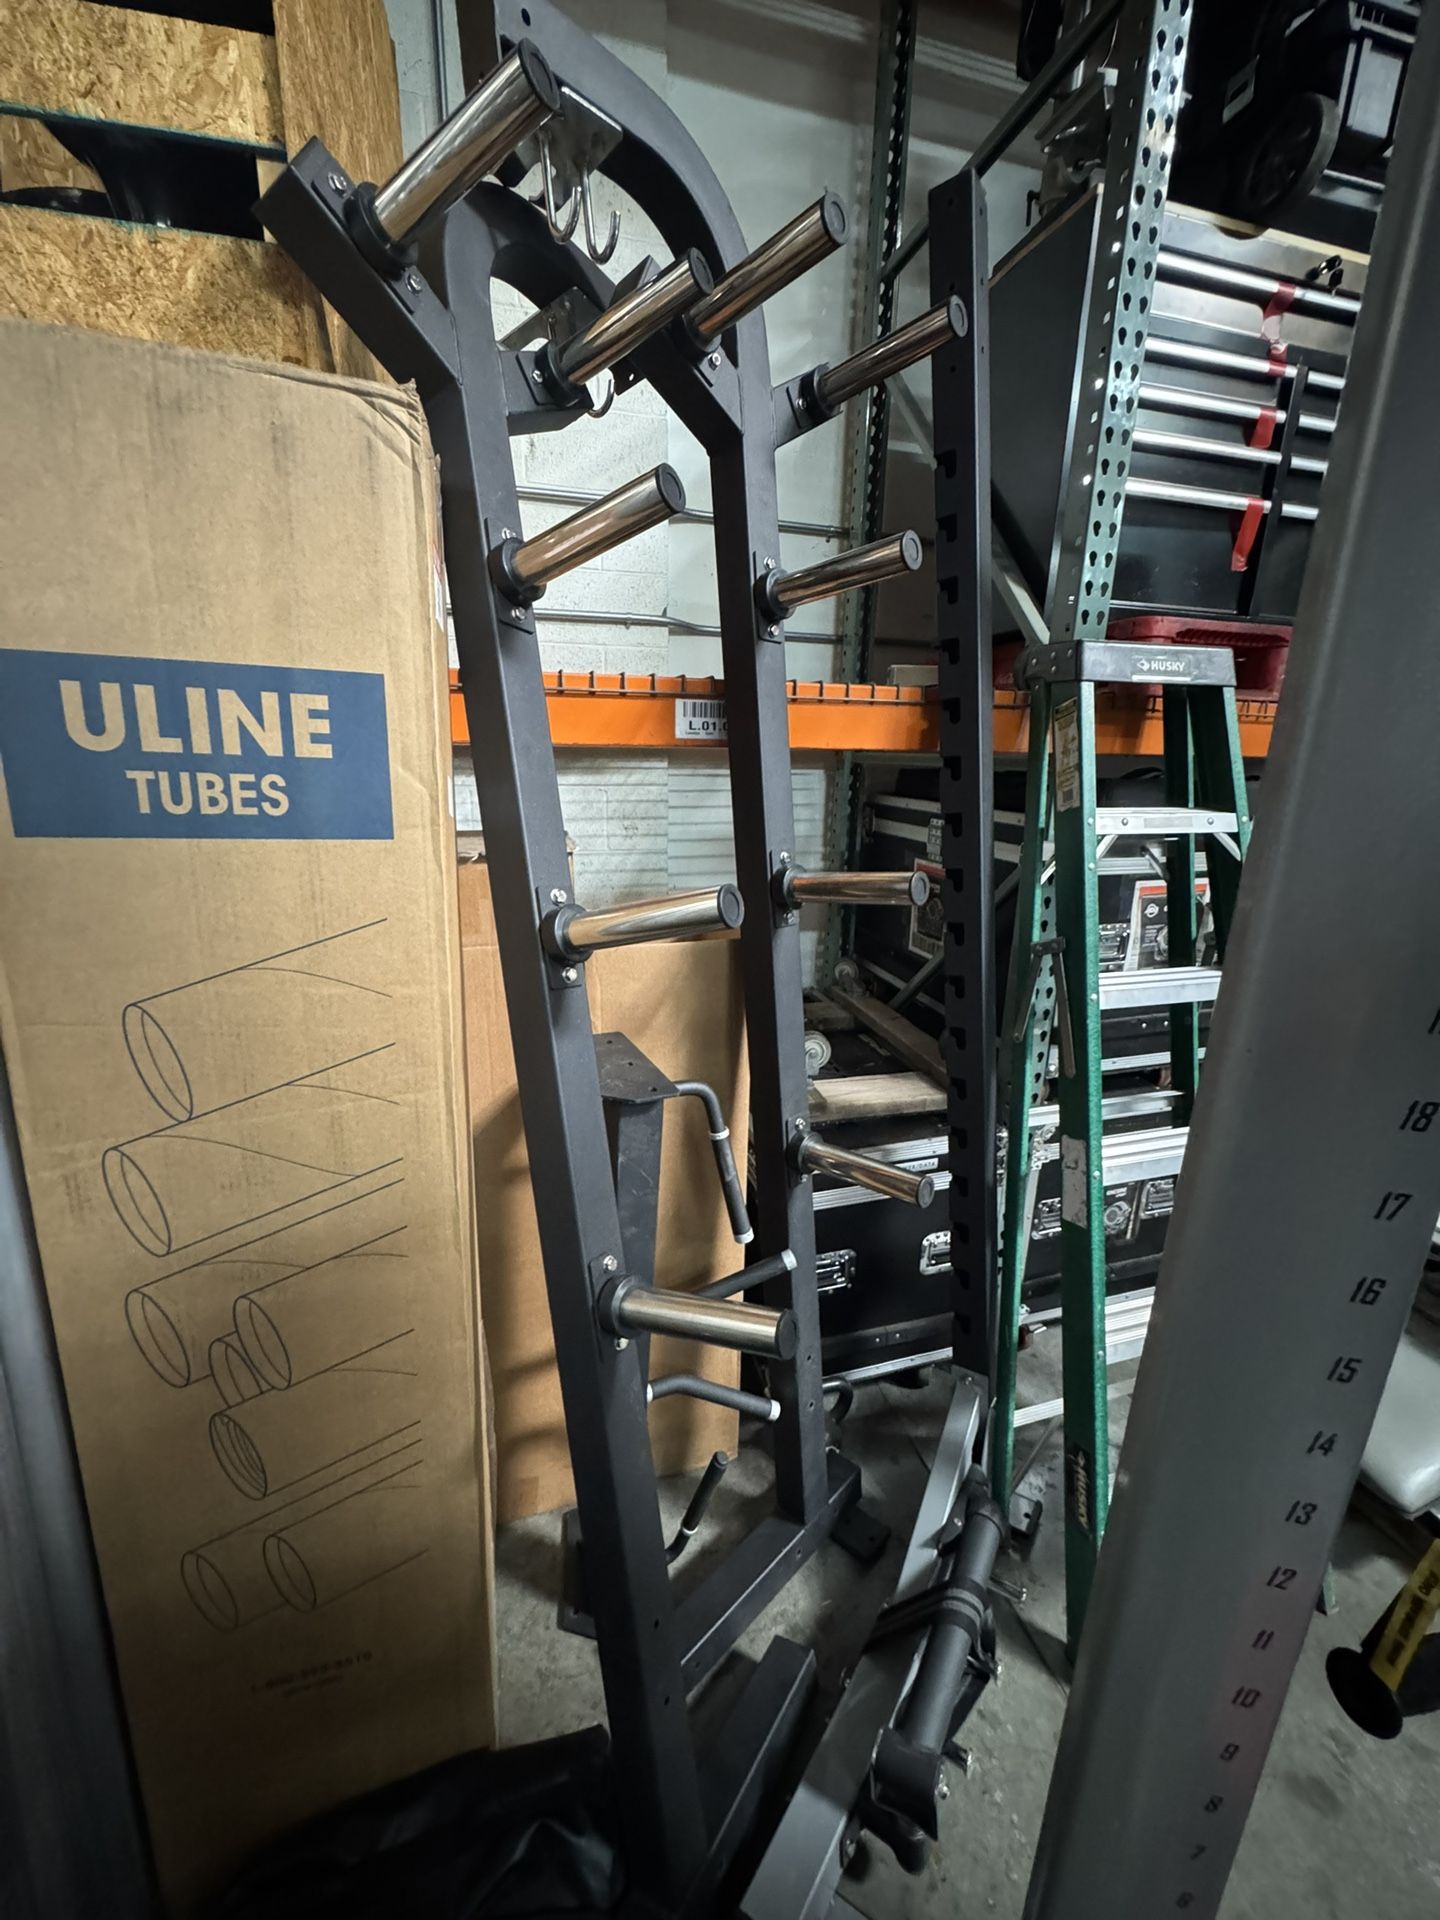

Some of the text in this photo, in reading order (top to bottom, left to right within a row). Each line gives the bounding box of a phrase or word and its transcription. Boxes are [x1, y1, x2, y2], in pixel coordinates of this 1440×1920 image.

[1151, 660, 1185, 671] HUSKY
[59, 680, 333, 759] ULINE
[125, 770, 289, 816] TUBES
[1428, 1008, 1440, 1035] 1
[1400, 1100, 1440, 1132] 18
[1373, 1191, 1413, 1221] 17
[1350, 1276, 1387, 1306] 16
[1327, 1356, 1363, 1384] 15
[1306, 1431, 1338, 1456] 14
[1285, 1500, 1317, 1525] 13
[1266, 1565, 1297, 1590] 12
[1252, 1629, 1275, 1650] 11
[1232, 1686, 1261, 1708] 10
[1220, 1743, 1240, 1762] 9
[1190, 1844, 1207, 1860] 7
